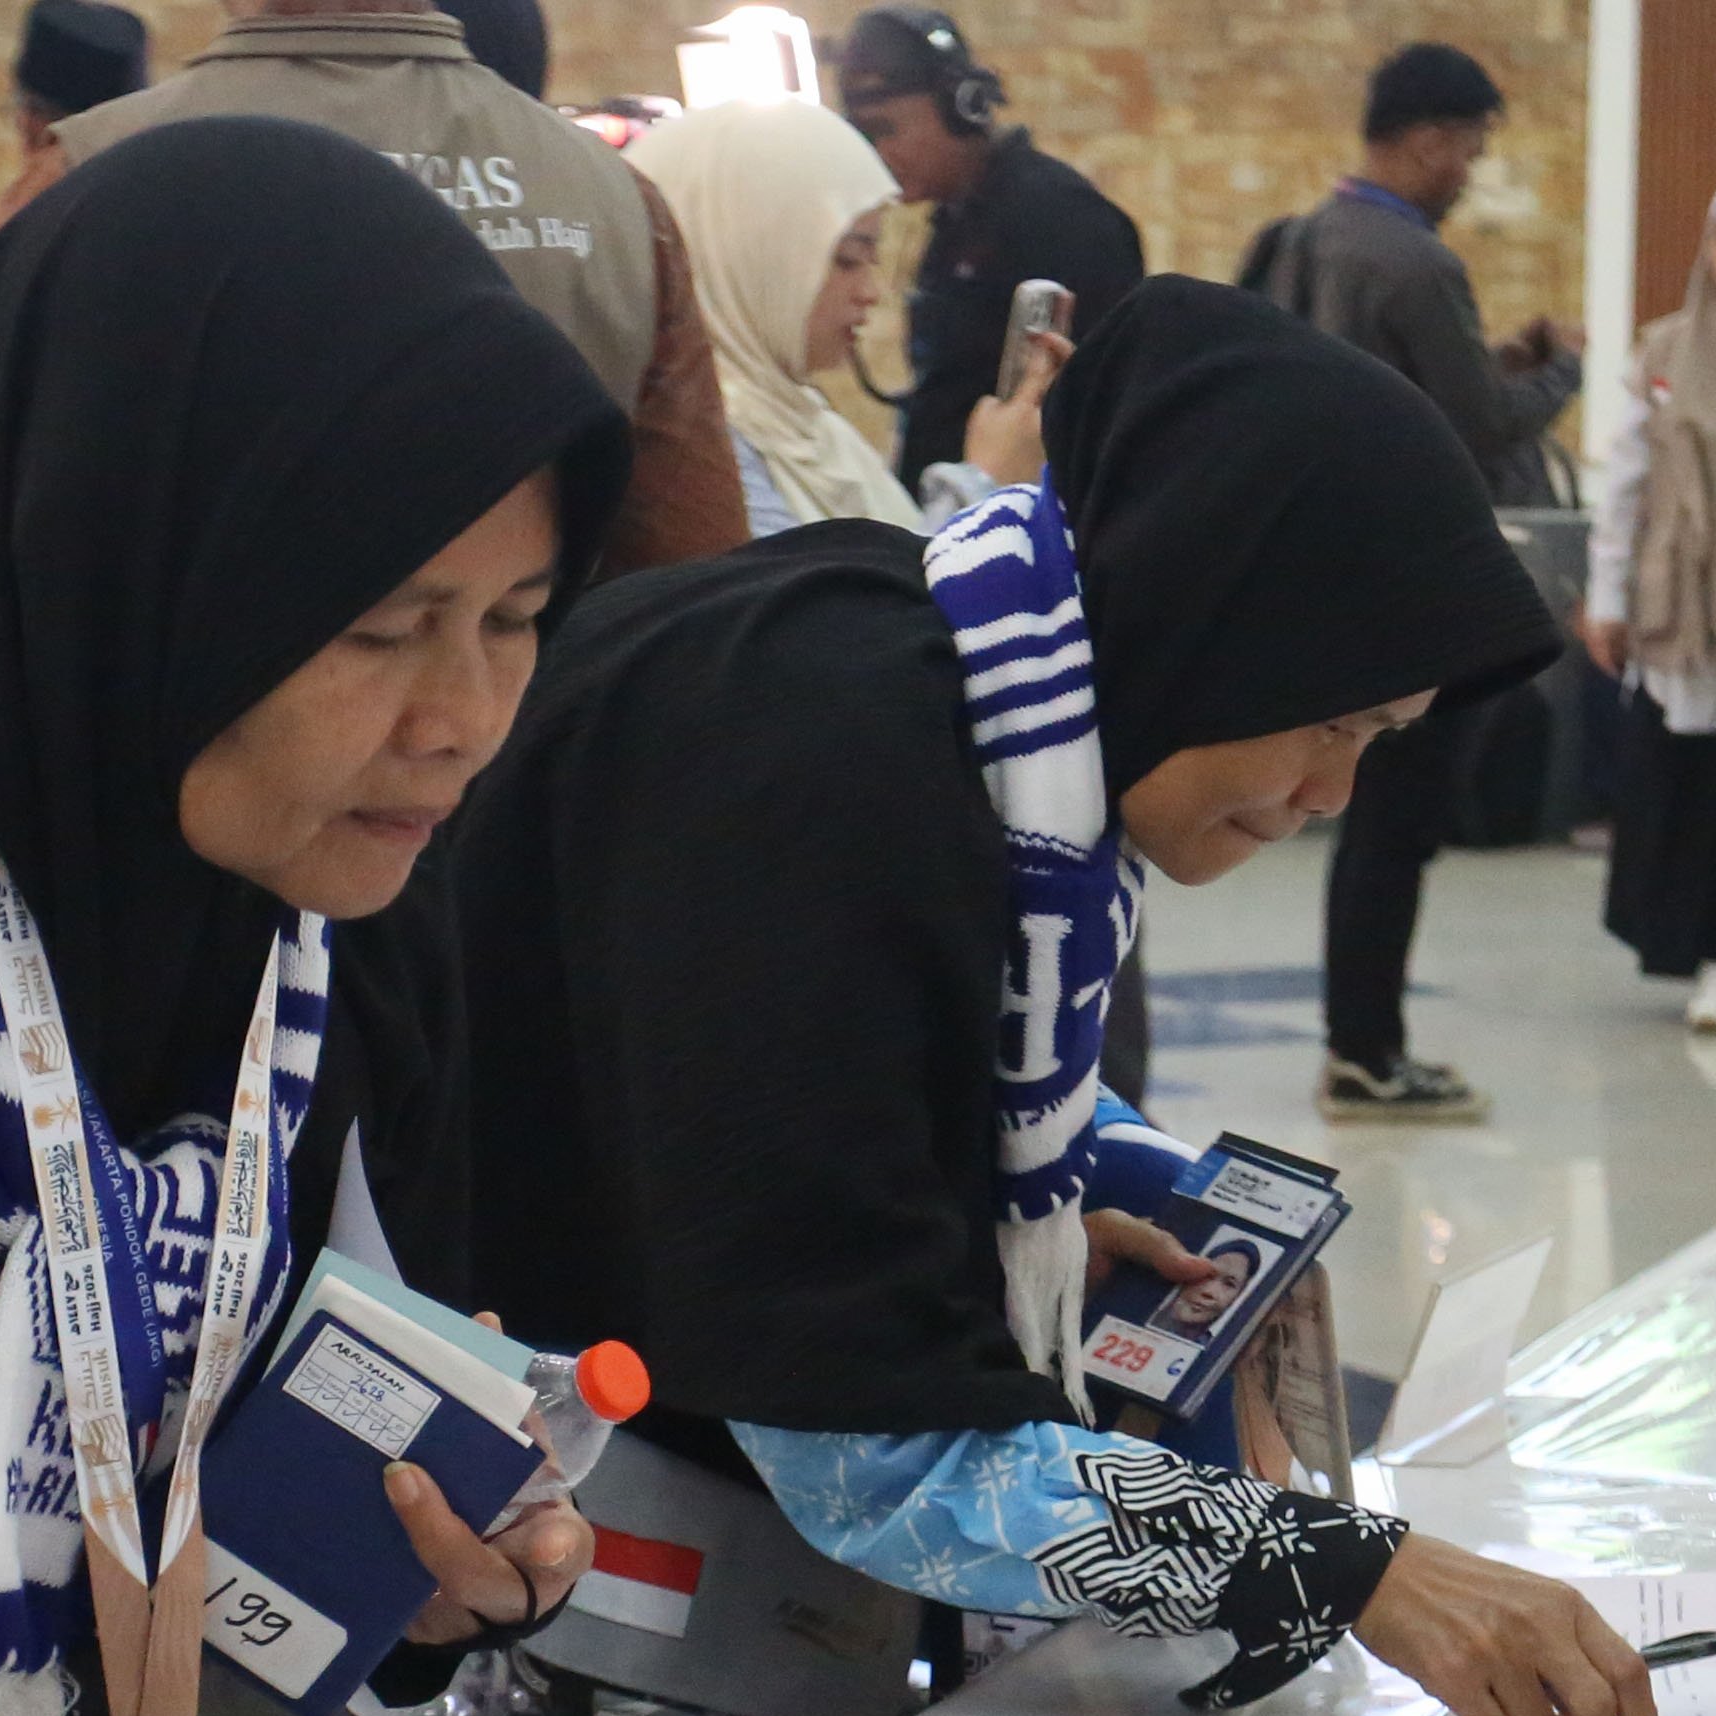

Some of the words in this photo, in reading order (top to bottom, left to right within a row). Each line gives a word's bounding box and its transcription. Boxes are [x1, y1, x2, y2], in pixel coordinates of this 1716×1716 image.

[86, 1111, 122, 1191] JAKARTA
[116, 1192, 145, 1268] PONDOK
[83, 1264, 98, 1299] 2026
[233, 1252, 249, 1286] 2026
[85, 1302, 102, 1332] Hajj
[135, 1272, 154, 1318] GEDE
[227, 1286, 244, 1319] Hajj
[142, 1321, 162, 1368] (JKG)
[1092, 1332, 1155, 1373] 229
[93, 1347, 115, 1408] nusuk
[204, 1577, 293, 1646] 199
